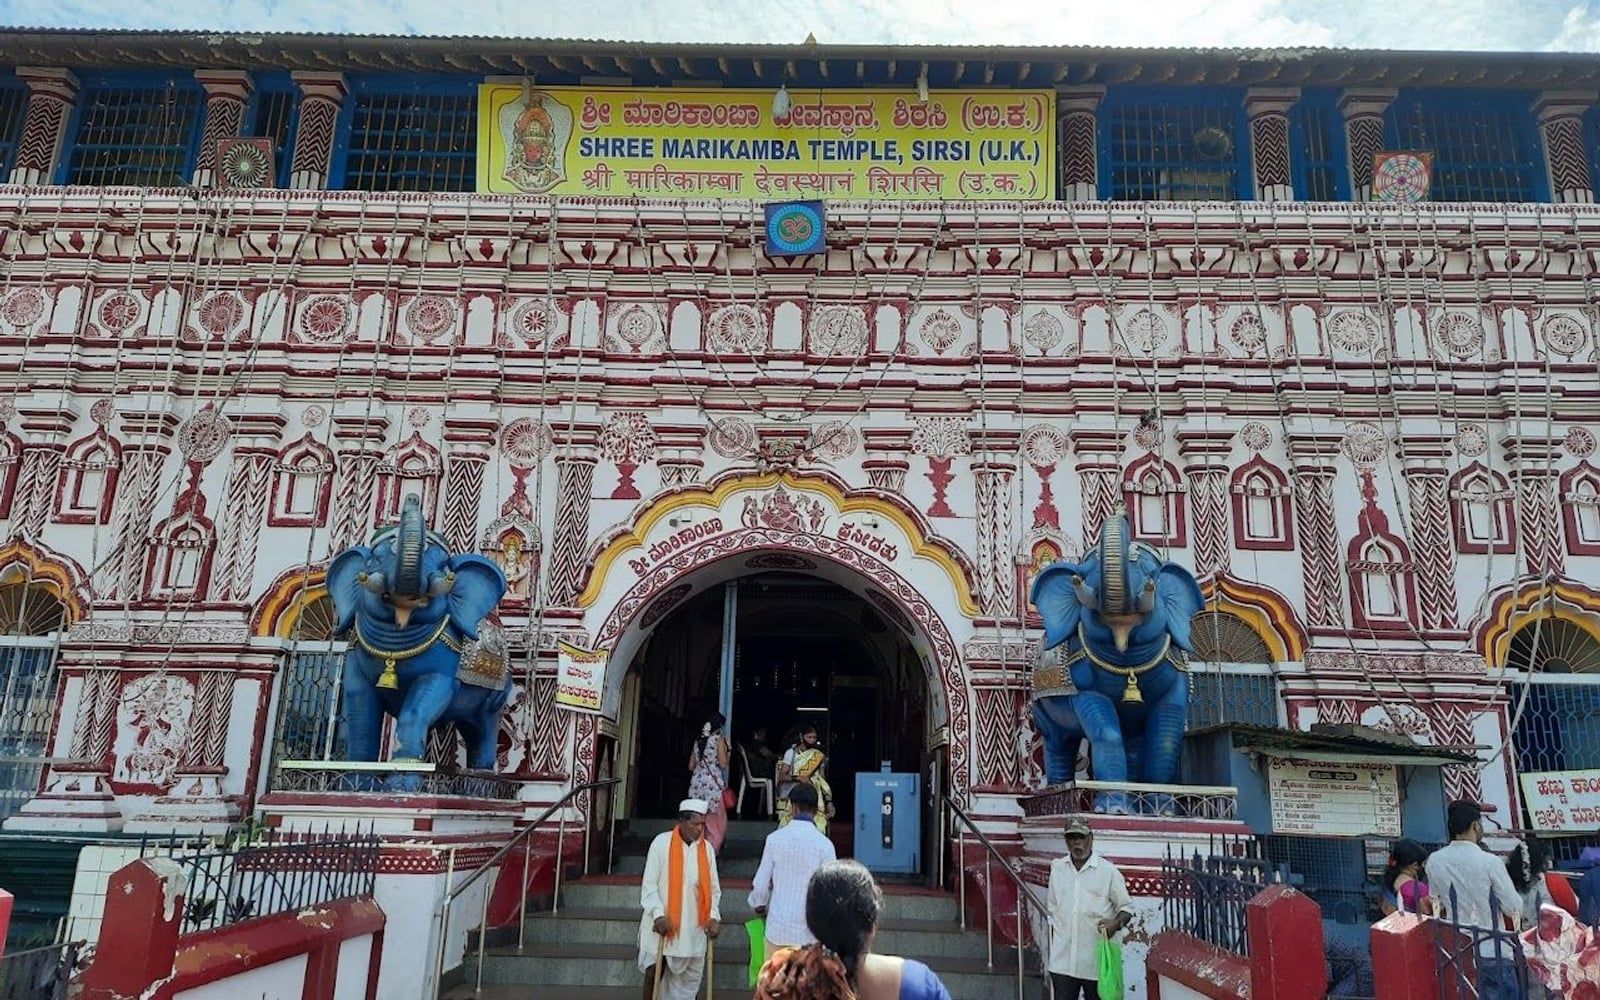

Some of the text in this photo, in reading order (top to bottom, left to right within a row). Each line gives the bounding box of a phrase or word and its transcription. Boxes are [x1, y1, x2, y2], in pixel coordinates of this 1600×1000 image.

[580, 96, 611, 131] ಶ್ರೀ
[624, 99, 760, 126] ಮಾರಿಕಾಂಬಾ
[893, 97, 947, 128] ಶಿರಸಿ
[962, 97, 1043, 132] (ಉ.ಕ.)
[580, 138, 1040, 166] SHREE MARIKAMBA TEMPLE, SIRSI (U.K.)
[582, 163, 614, 189] श्री
[623, 164, 743, 192] मारिकाम्बा
[866, 166, 945, 193] शिरसि
[958, 170, 1038, 197] (उ.क.)
[628, 518, 898, 577] ಶ್ರೀ ಮಾರಿಕಾಂಬಾ ಪ್ರಸೀದತು
